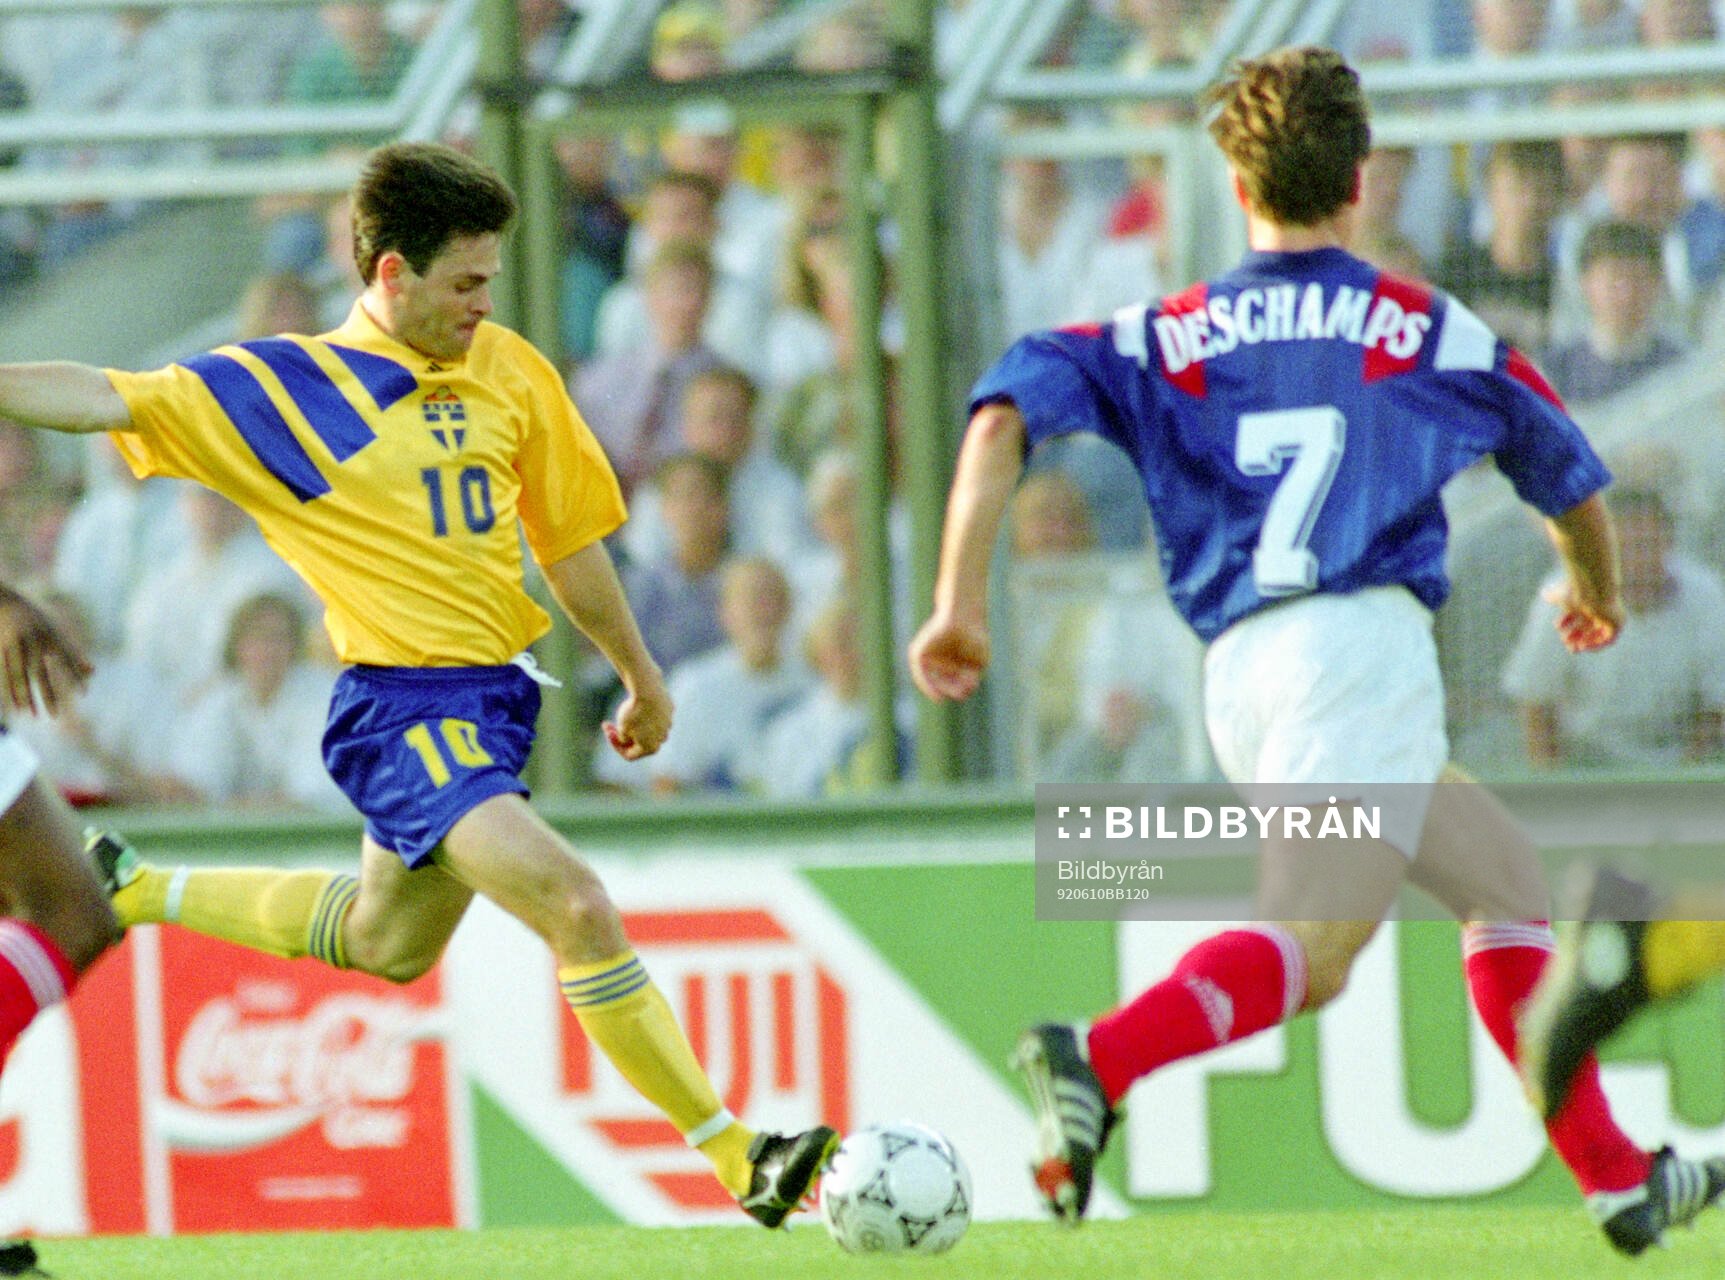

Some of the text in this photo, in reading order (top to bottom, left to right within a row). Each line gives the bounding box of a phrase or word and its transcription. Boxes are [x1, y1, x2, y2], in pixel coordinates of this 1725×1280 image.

[1153, 283, 1432, 374] DESCHAMPS
[420, 465, 495, 538] 10
[1235, 406, 1347, 596] 7
[403, 717, 494, 789] 10
